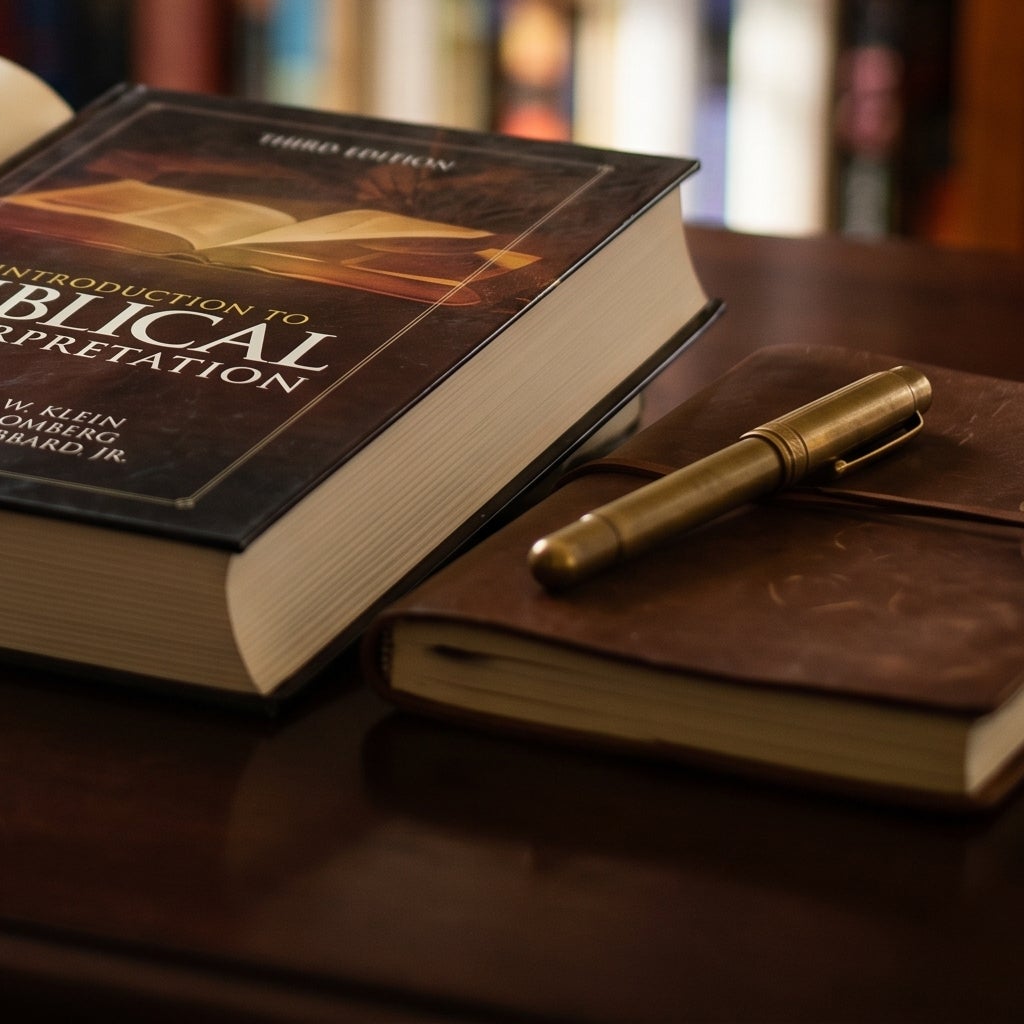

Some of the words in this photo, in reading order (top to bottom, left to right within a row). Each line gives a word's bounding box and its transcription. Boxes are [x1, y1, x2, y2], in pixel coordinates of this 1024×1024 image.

[259, 132, 340, 154] THIRD
[343, 146, 456, 171] EDITION
[264, 309, 310, 325] TO
[4, 398, 34, 413] W.
[39, 405, 127, 429] KLEIN
[88, 446, 127, 464] JR.
